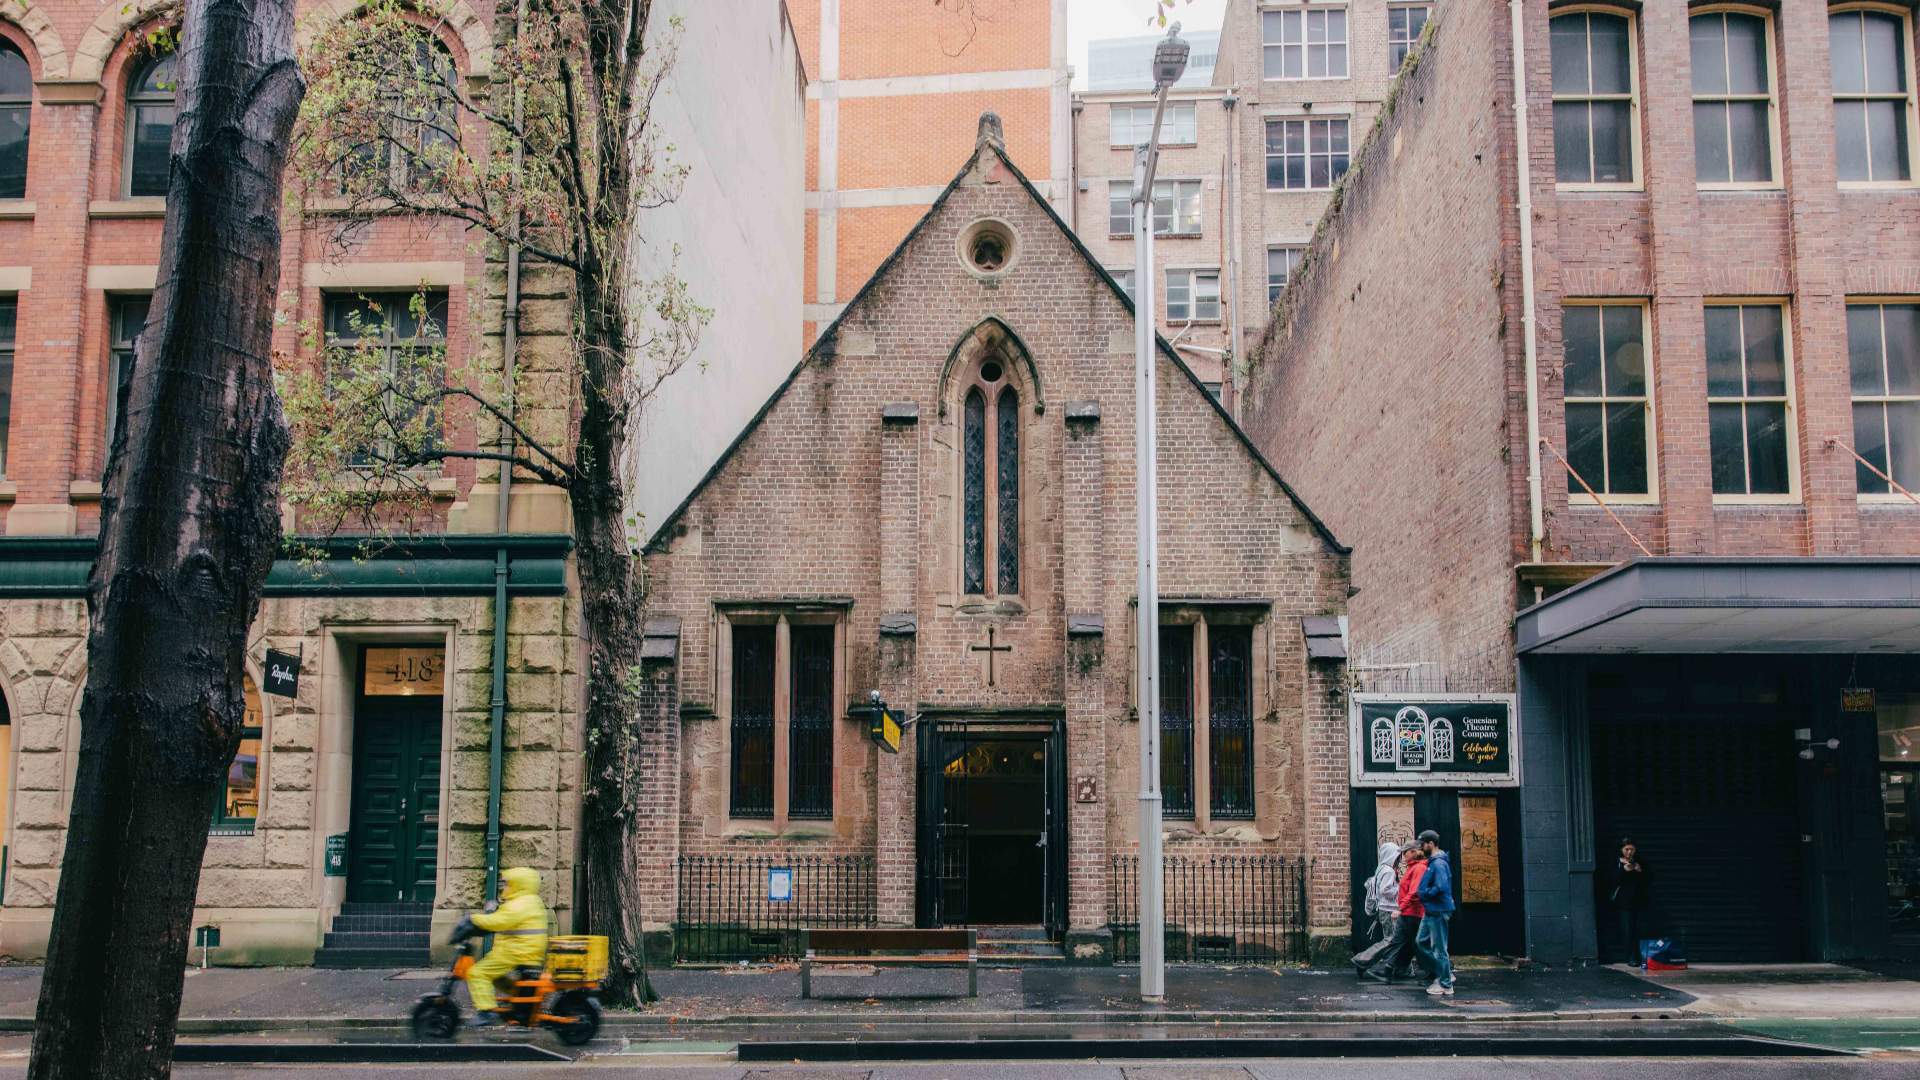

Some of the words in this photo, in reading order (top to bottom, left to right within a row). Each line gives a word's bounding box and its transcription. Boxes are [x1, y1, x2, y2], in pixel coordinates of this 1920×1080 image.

[271, 663, 294, 685] Rapha
[385, 656, 433, 682] 418
[1465, 723, 1496, 731] Theatre
[1462, 730, 1499, 739] Company
[1462, 742, 1499, 756] Celebrating
